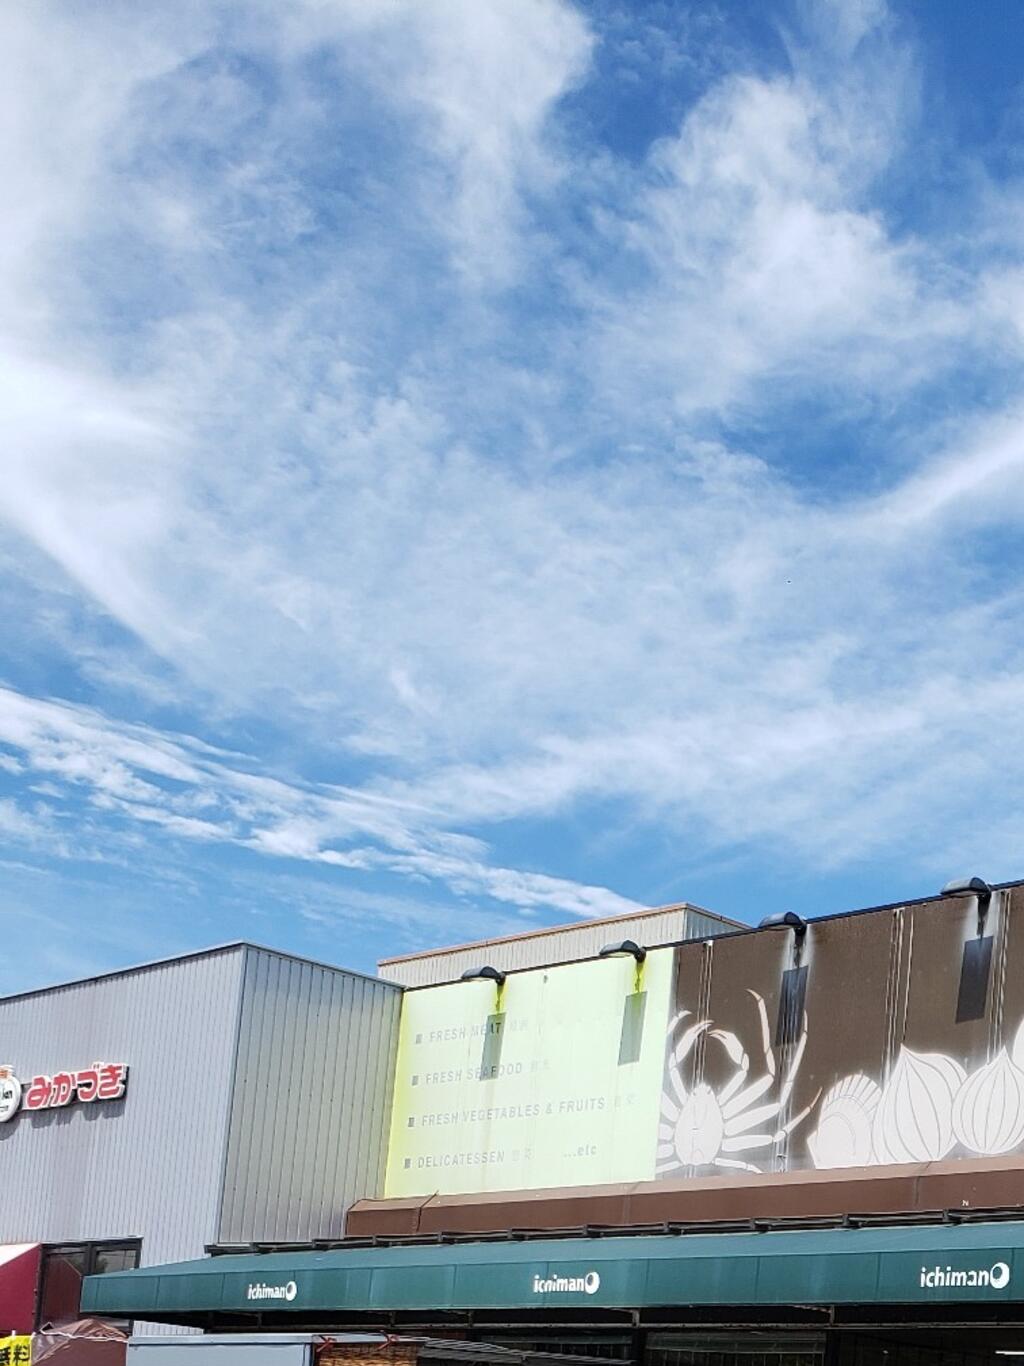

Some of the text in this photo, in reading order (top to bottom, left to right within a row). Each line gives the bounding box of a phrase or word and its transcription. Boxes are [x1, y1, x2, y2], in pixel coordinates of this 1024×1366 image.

[429, 1027, 466, 1042] FRESH
[425, 1067, 463, 1084] FRESH
[467, 1062, 523, 1081] SEAFOOD
[26, 1062, 125, 1109] みかづき
[421, 1110, 460, 1127] FRESH
[463, 1105, 540, 1123] VEGETABLES
[559, 1097, 606, 1113] FRUITS
[417, 1150, 505, 1169] DELICATESSEN
